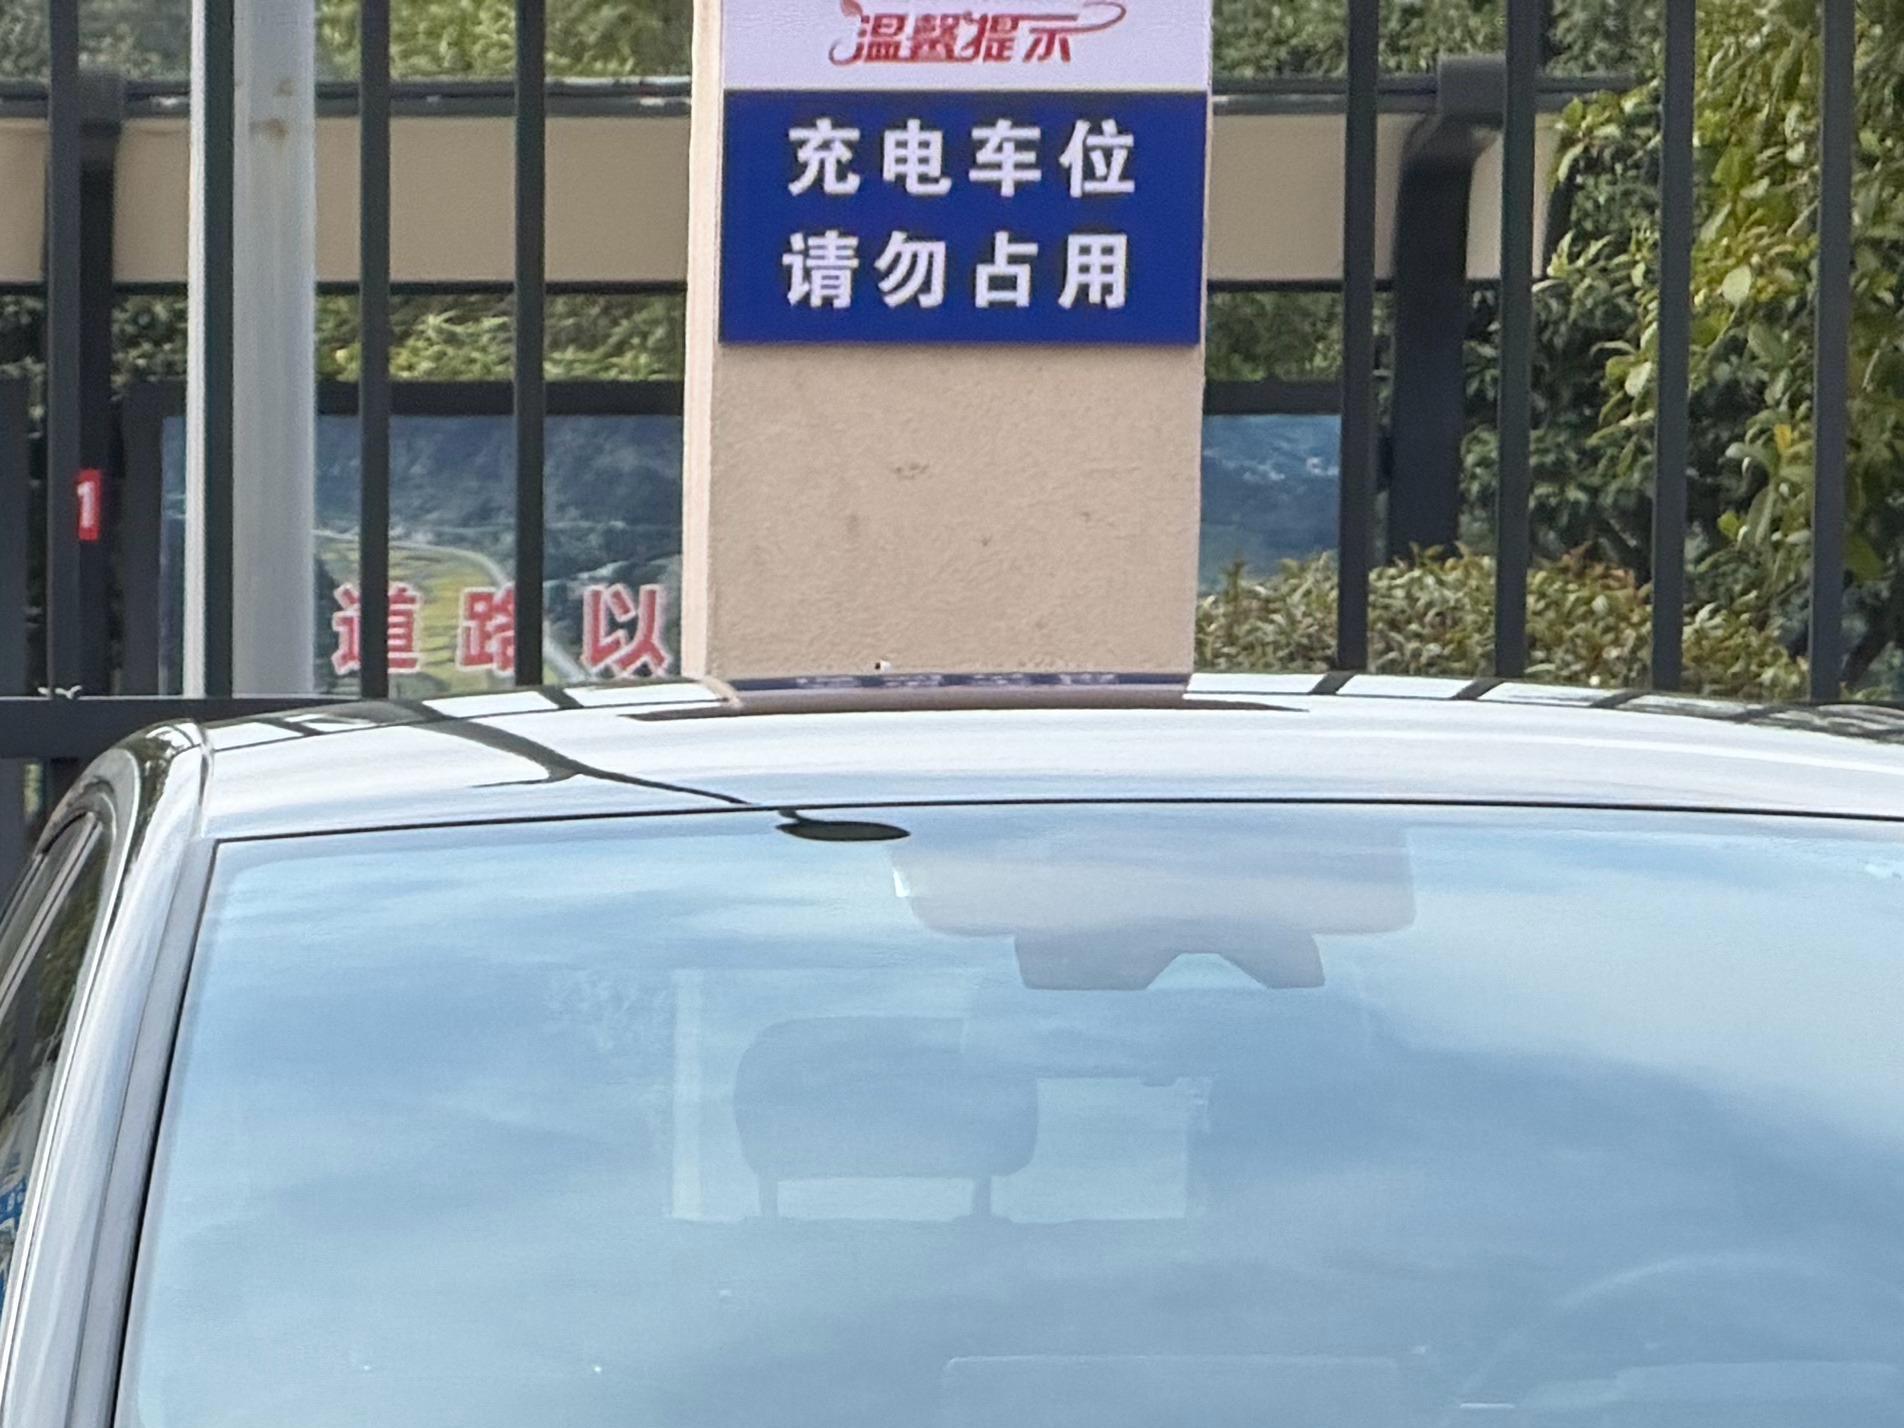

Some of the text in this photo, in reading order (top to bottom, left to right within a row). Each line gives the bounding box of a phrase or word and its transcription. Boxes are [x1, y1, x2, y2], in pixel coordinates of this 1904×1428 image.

[787, 117, 1136, 198] 充电车位
[782, 229, 1129, 309] 请勿占用
